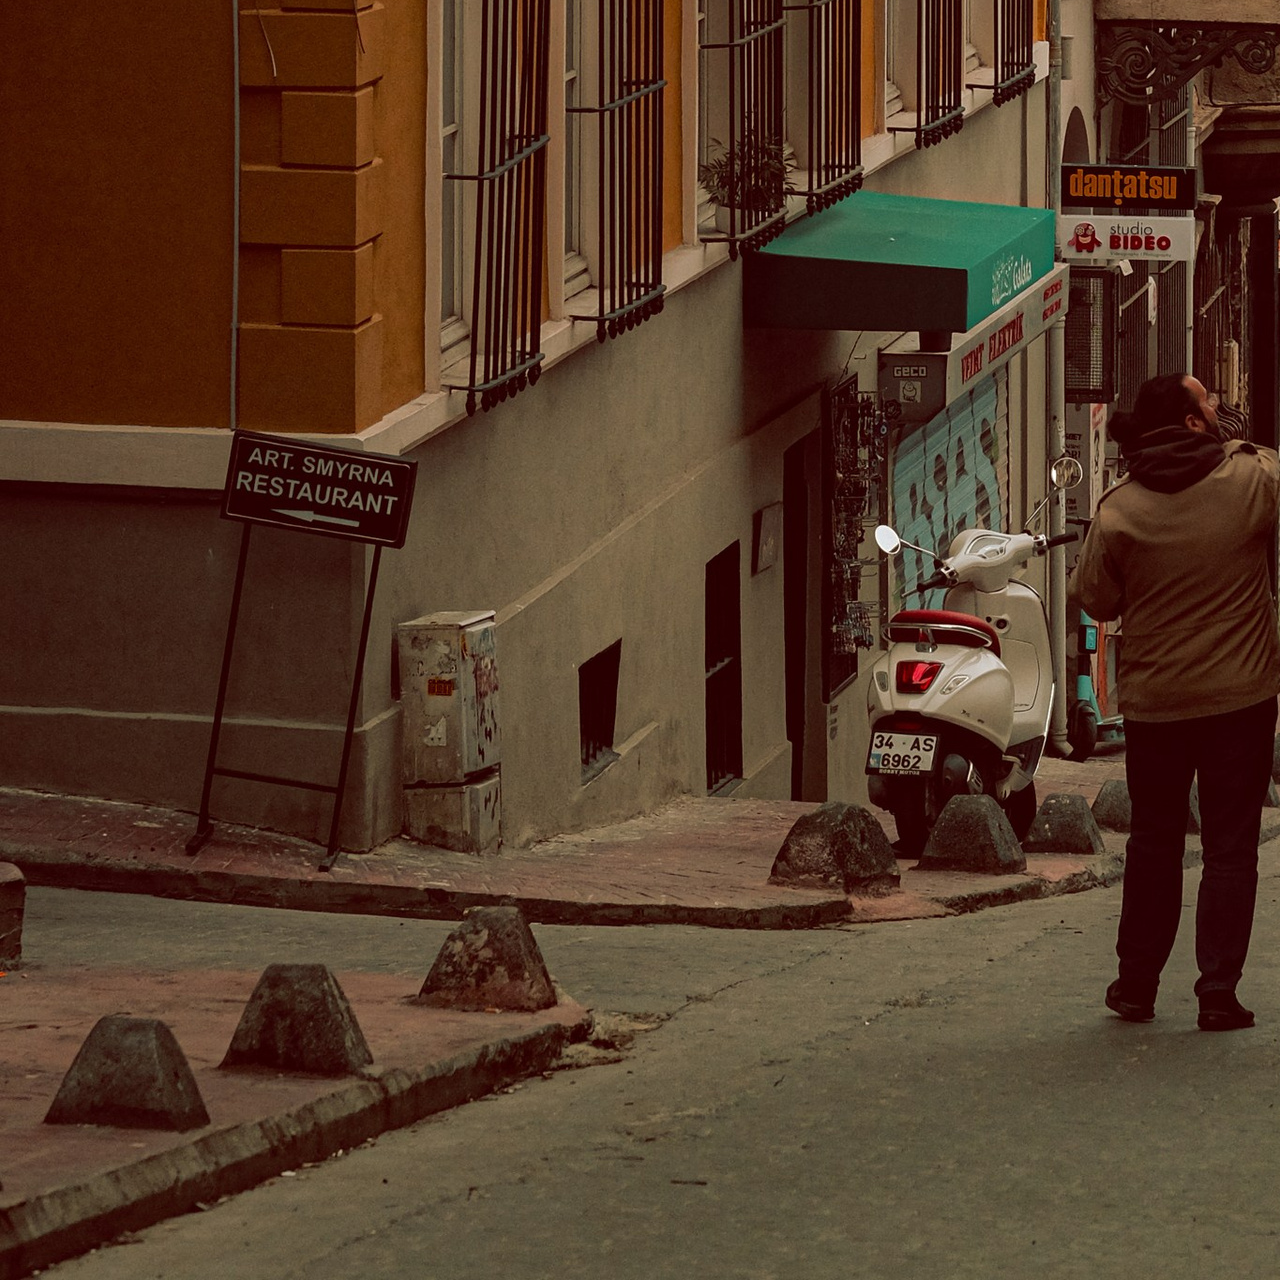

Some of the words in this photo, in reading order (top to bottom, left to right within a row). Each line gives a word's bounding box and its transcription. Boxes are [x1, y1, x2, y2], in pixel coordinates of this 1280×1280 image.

[1110, 221, 1153, 235] studio
[1109, 235, 1171, 251] BIDEO
[961, 342, 985, 385] VEDAT
[988, 311, 1025, 364] ELEKTRİK
[248, 448, 295, 470] ART.
[302, 456, 394, 487] SMYRNA
[236, 471, 398, 515] RESTAURANT
[874, 734, 894, 749] 34
[910, 737, 934, 752] AS
[881, 753, 922, 769] 6962
